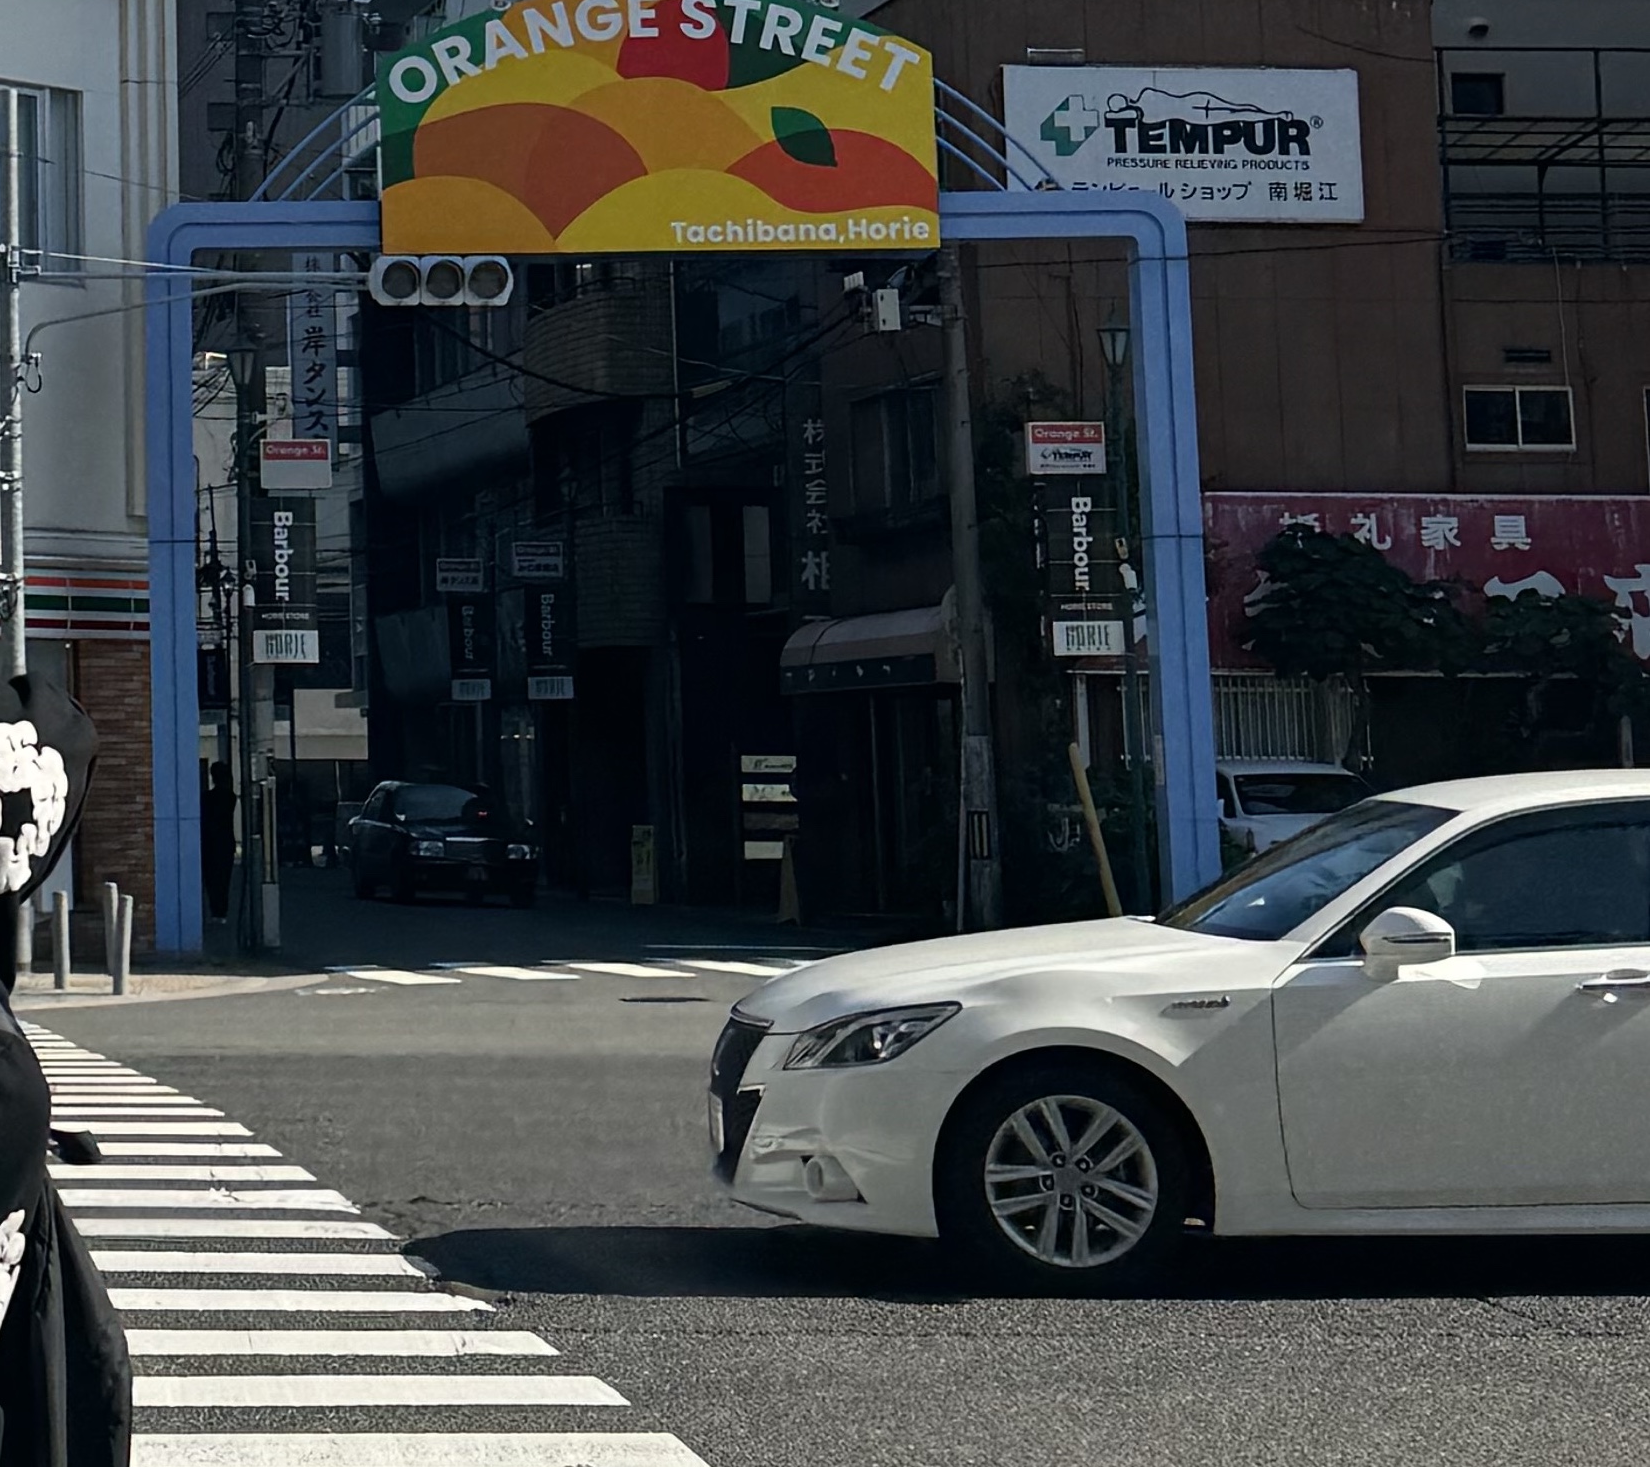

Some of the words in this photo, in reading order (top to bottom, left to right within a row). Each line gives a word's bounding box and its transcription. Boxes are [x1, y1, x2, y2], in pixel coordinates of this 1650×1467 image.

[1105, 117, 1311, 156] TEMPUR
[1107, 157, 1170, 169] PRESSURE
[1175, 158, 1238, 170] RELIEVING
[1242, 159, 1310, 171] PRODUCTS
[1268, 181, 1338, 202] 南堀江
[1034, 427, 1080, 441] Orange
[265, 443, 308, 457] Orange
[273, 511, 294, 601] Barbour
[1071, 496, 1093, 592] Barbour
[540, 593, 556, 657] Barbour
